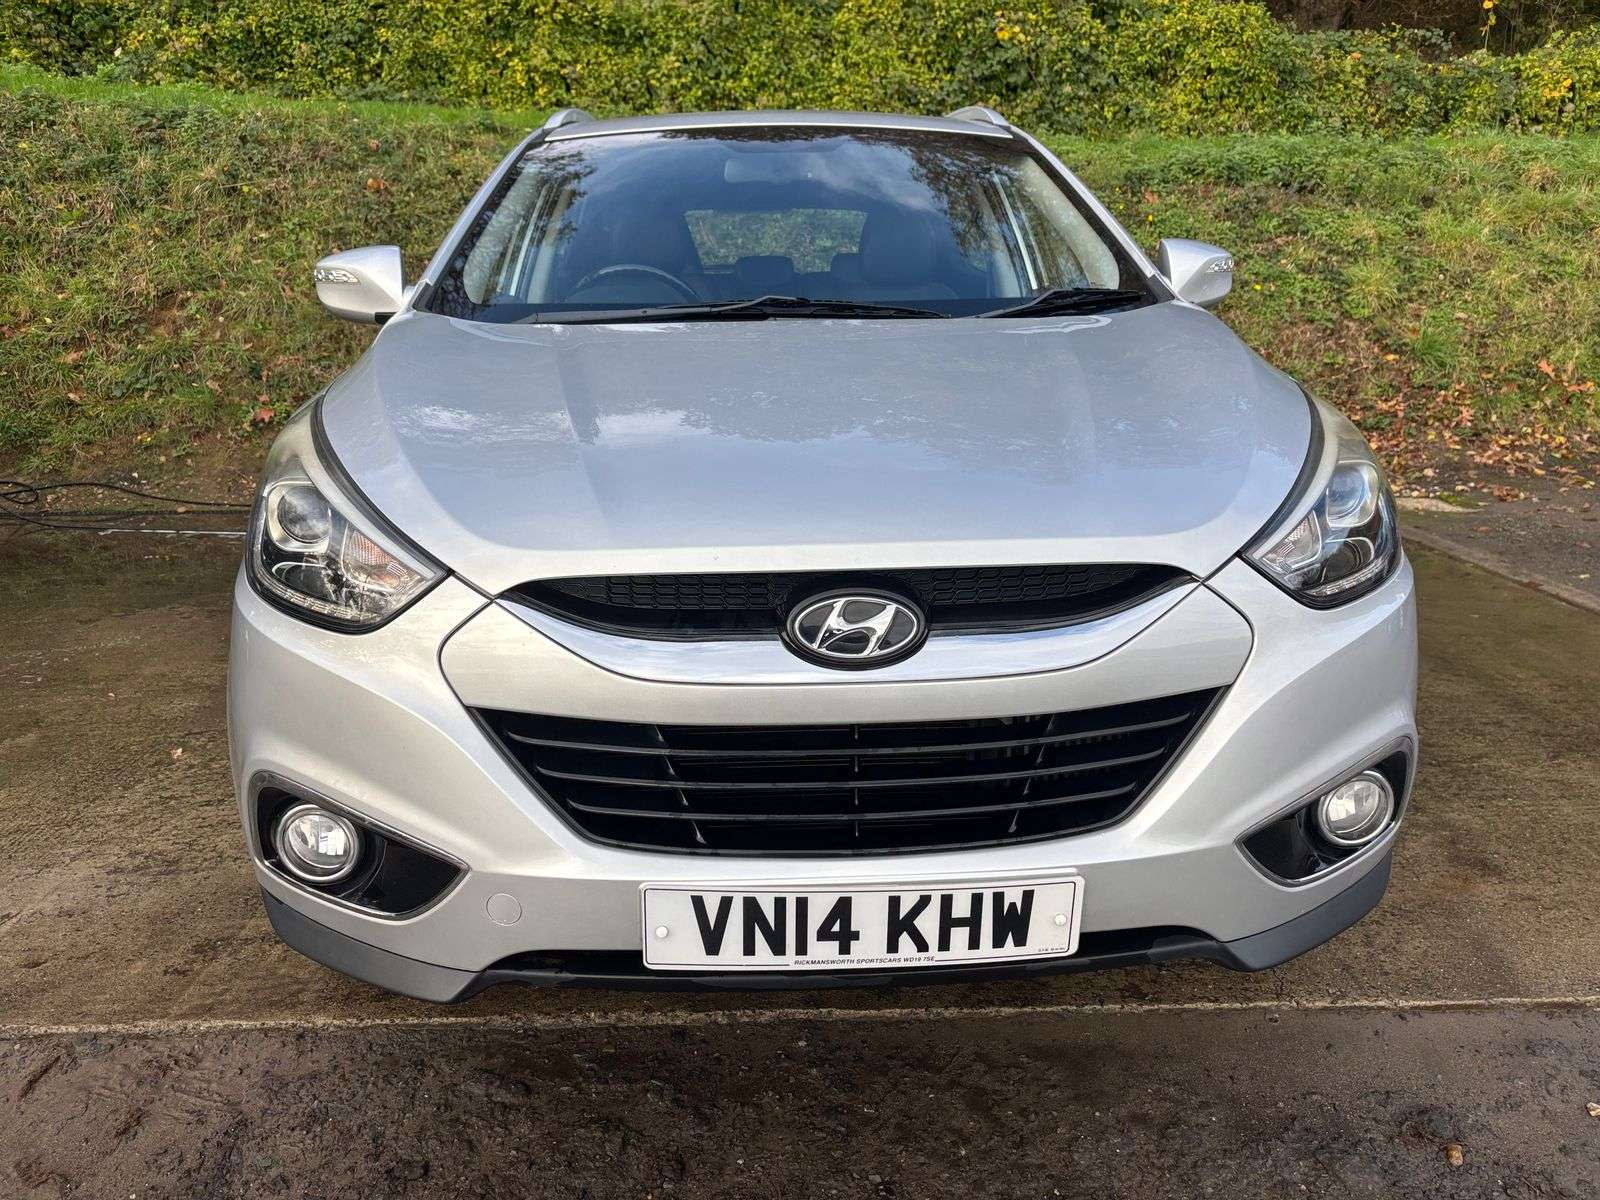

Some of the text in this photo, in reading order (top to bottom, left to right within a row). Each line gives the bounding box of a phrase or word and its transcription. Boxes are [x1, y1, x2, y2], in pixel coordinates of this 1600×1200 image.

[691, 889, 1035, 957] VN14 KHW
[794, 958, 855, 966] RICKMANSWORTH
[857, 957, 902, 965] SPORTSCARS
